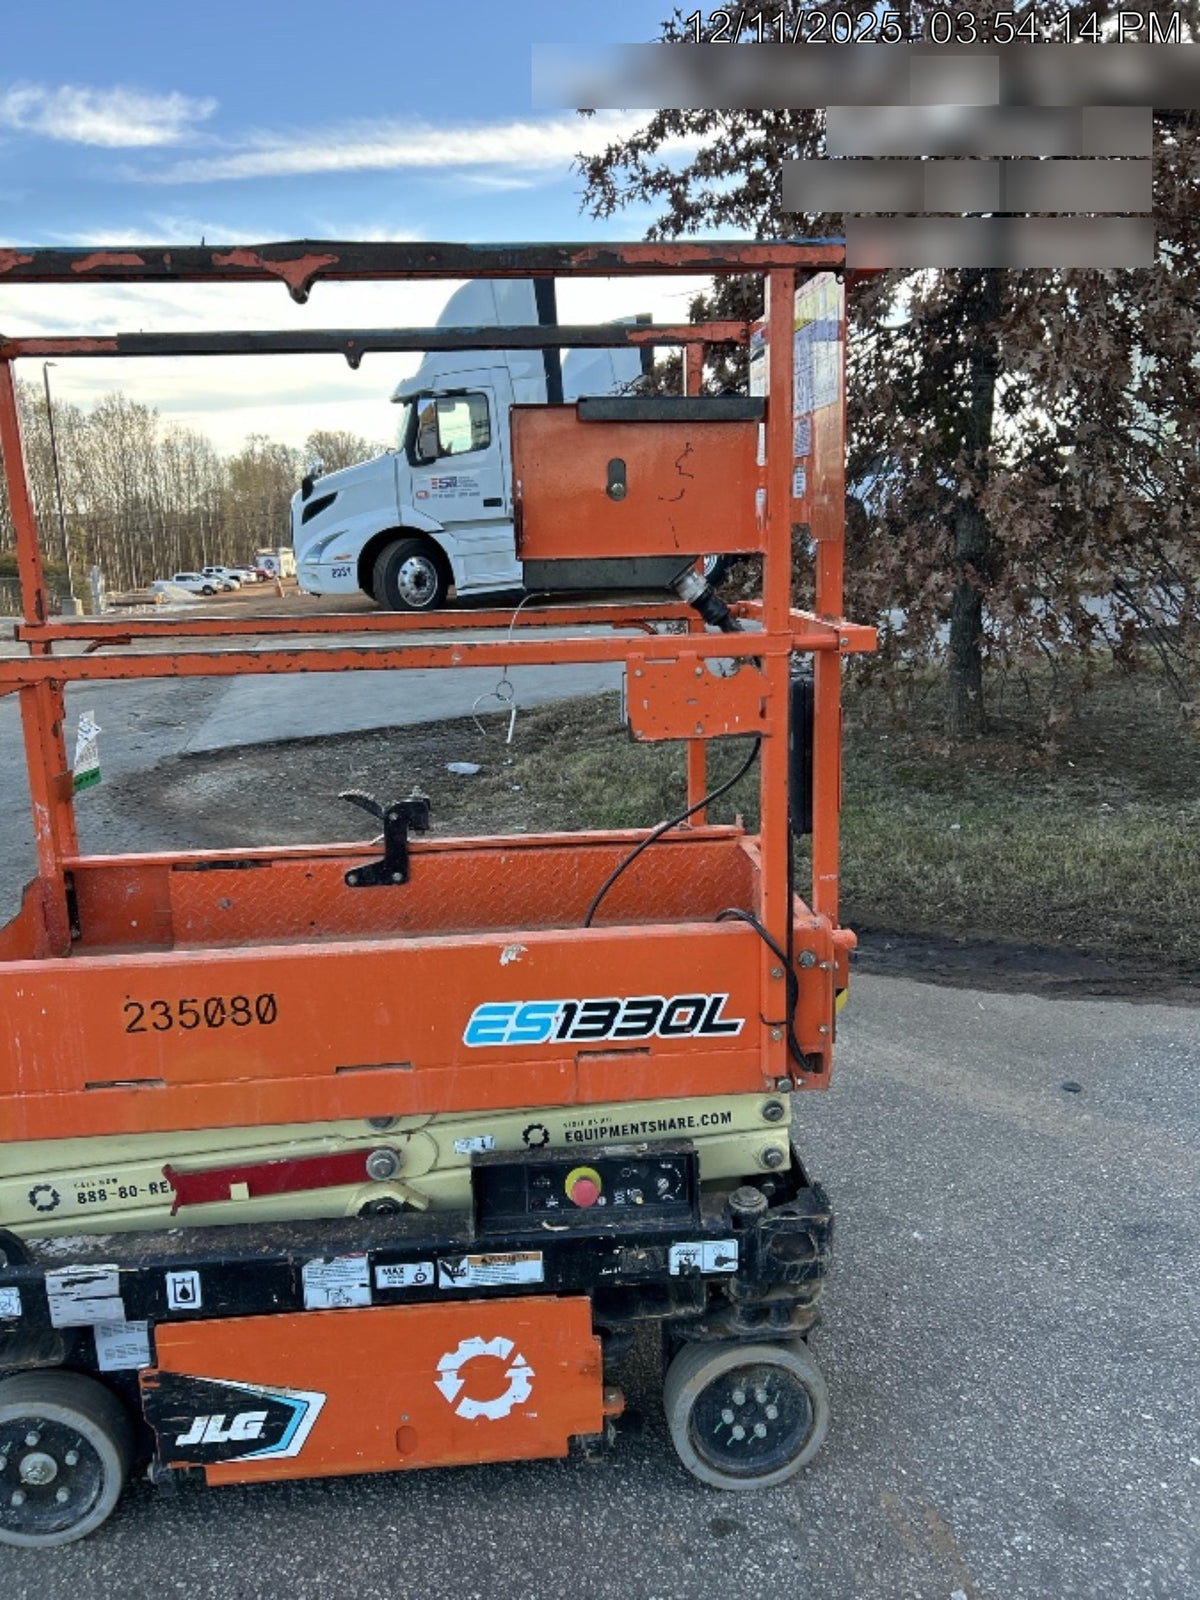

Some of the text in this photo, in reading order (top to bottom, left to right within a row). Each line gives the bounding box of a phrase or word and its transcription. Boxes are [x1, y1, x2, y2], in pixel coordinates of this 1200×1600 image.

[124, 994, 278, 1033] 235080
[463, 994, 744, 1046] ES1330L
[565, 1111, 732, 1143] EQUIPMENTSHARE.COM
[175, 1411, 269, 1446] JLG
